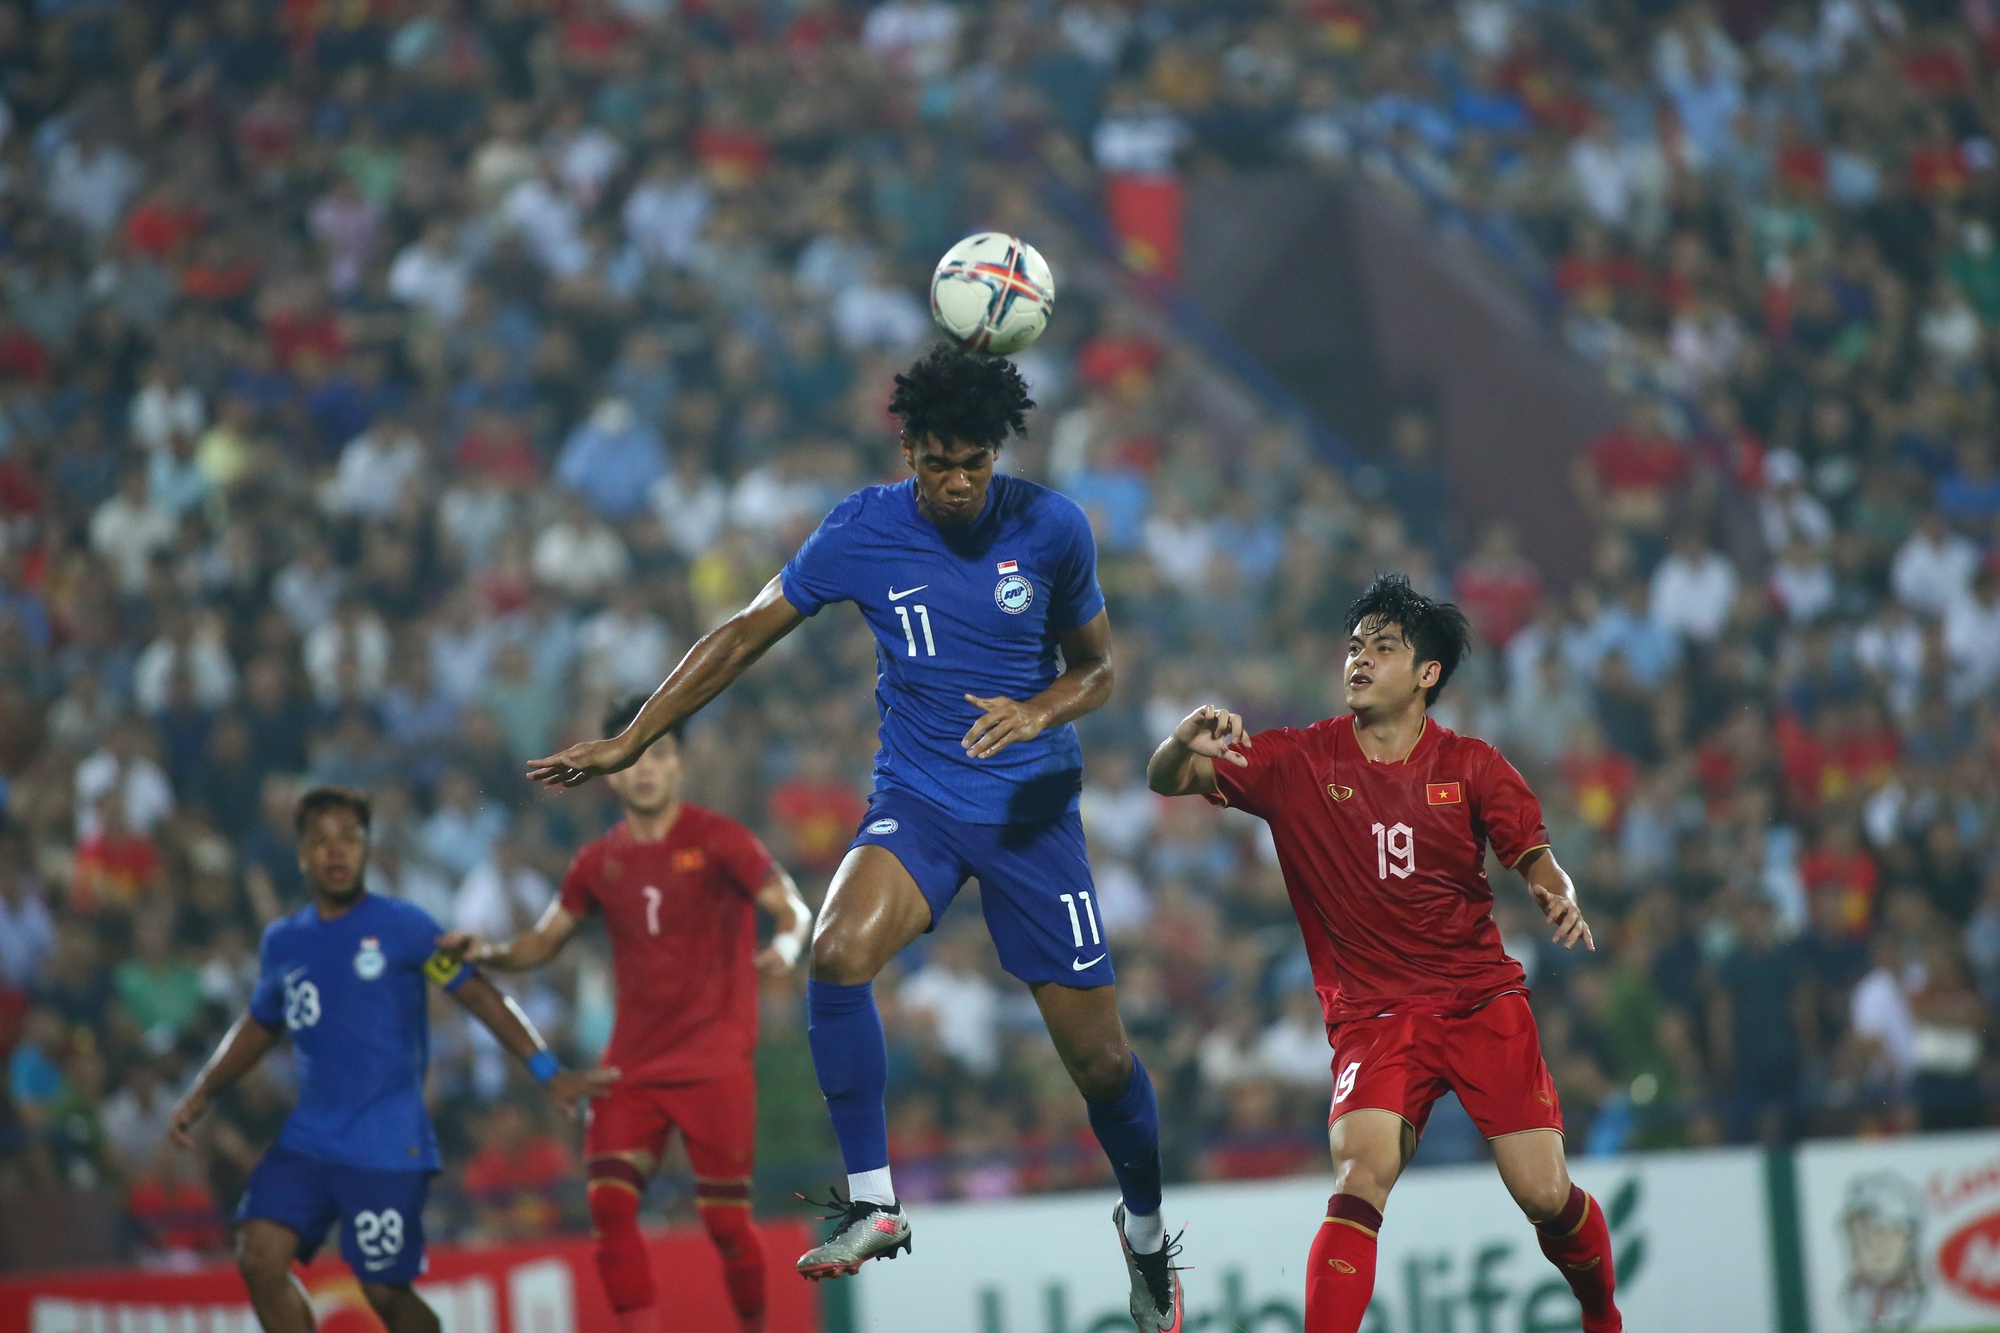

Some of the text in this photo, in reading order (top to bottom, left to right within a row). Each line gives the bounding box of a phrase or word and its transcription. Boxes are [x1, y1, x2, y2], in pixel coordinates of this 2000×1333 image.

[894, 604, 936, 657] 11
[1371, 821, 1416, 880] 19
[1059, 890, 1100, 947] 11
